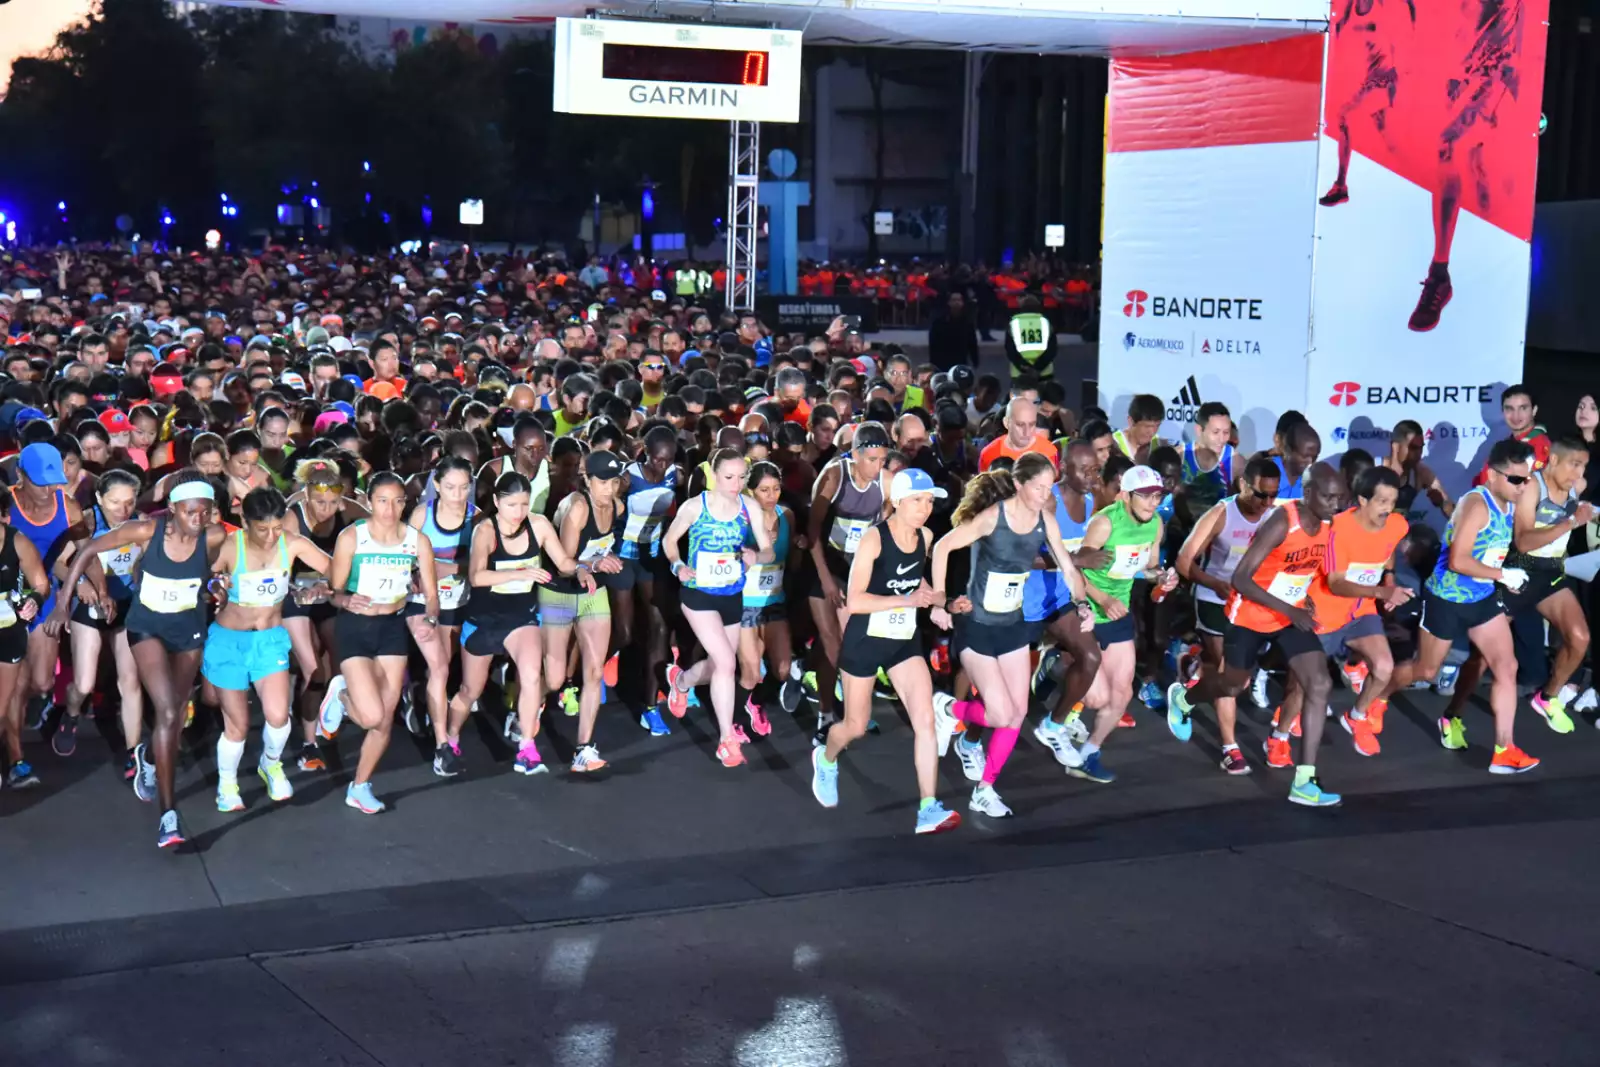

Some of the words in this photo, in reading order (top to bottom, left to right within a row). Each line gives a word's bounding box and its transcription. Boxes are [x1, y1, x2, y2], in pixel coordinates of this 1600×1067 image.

[743, 51, 764, 86] 0
[629, 84, 738, 107] GARMIN
[1152, 296, 1263, 320] BANORTE
[1021, 329, 1043, 345] 183
[1215, 338, 1262, 354] DELTA
[1366, 386, 1494, 405] BANORTE
[1440, 427, 1488, 439] DELTA
[114, 553, 131, 563] 48
[1125, 557, 1139, 568] 34
[709, 564, 732, 575] 100
[379, 578, 393, 590] 71
[759, 575, 774, 586] 78
[1357, 573, 1376, 583] 60
[256, 583, 278, 596] 90
[1004, 587, 1018, 599] 81
[1284, 586, 1303, 598] 39
[162, 590, 178, 602] 15
[888, 613, 907, 625] 85
